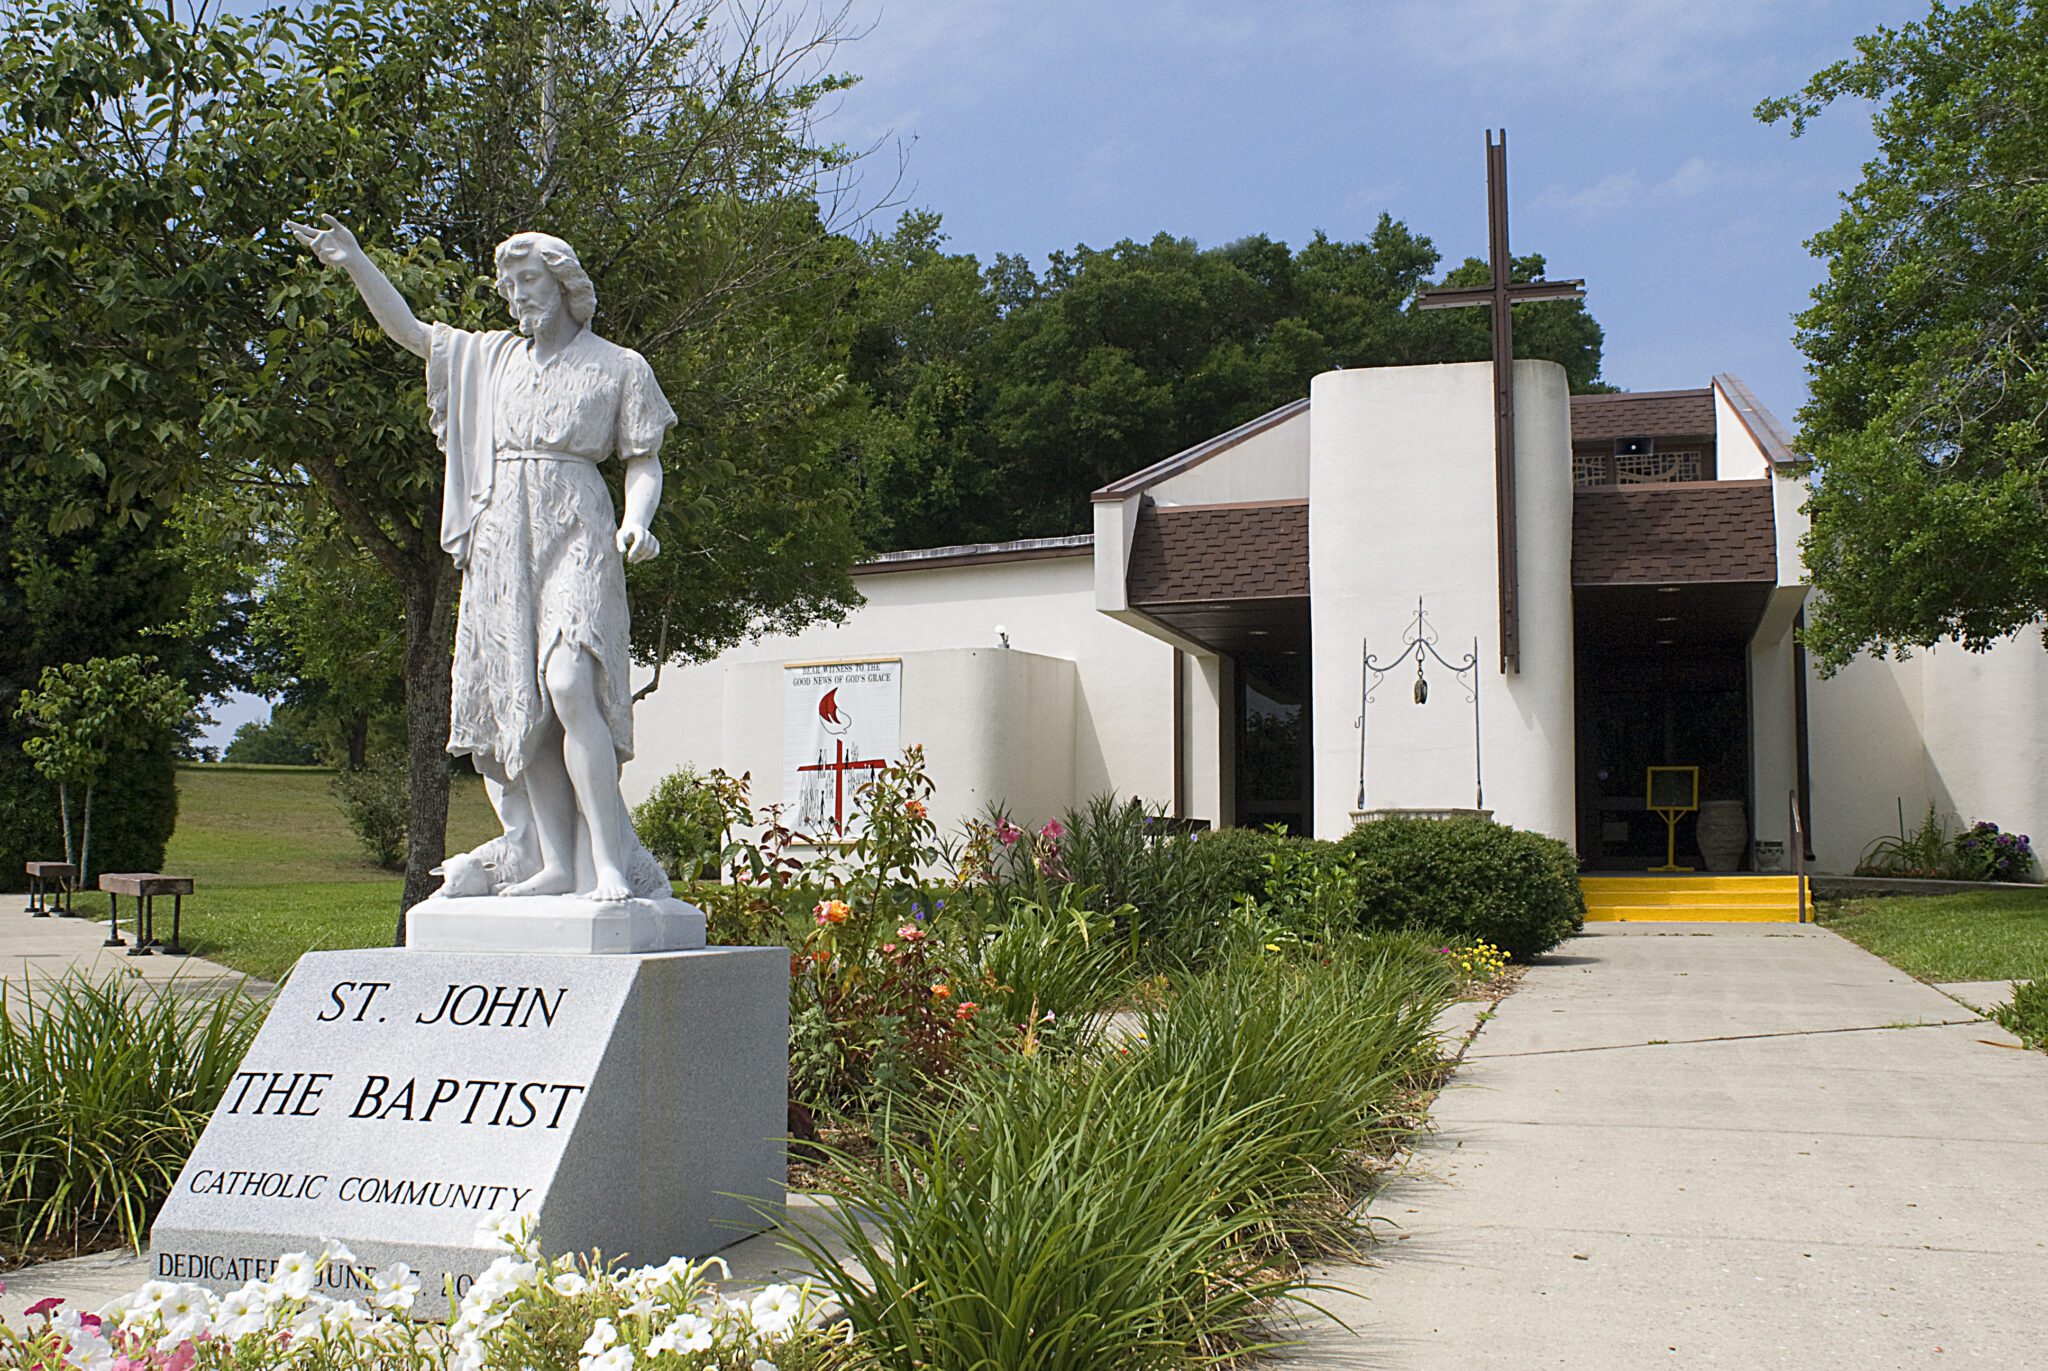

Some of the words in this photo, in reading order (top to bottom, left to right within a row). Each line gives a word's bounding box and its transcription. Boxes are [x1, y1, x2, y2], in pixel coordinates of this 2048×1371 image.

[793, 677, 811, 686] GOOD
[813, 676, 832, 685] NEWS
[834, 676, 842, 684] OF
[845, 674, 866, 684] GOD'S
[867, 673, 891, 683] GRACE
[823, 664, 853, 674] WITNESS
[855, 663, 864, 672] TO
[866, 662, 880, 672] THE
[317, 981, 390, 1023] ST.
[416, 984, 568, 1028] JOHN
[227, 1072, 333, 1116] THE
[349, 1075, 585, 1129] BAPTIST
[189, 1169, 327, 1200] CATHOLIC
[338, 1176, 532, 1212] COMMUNITY
